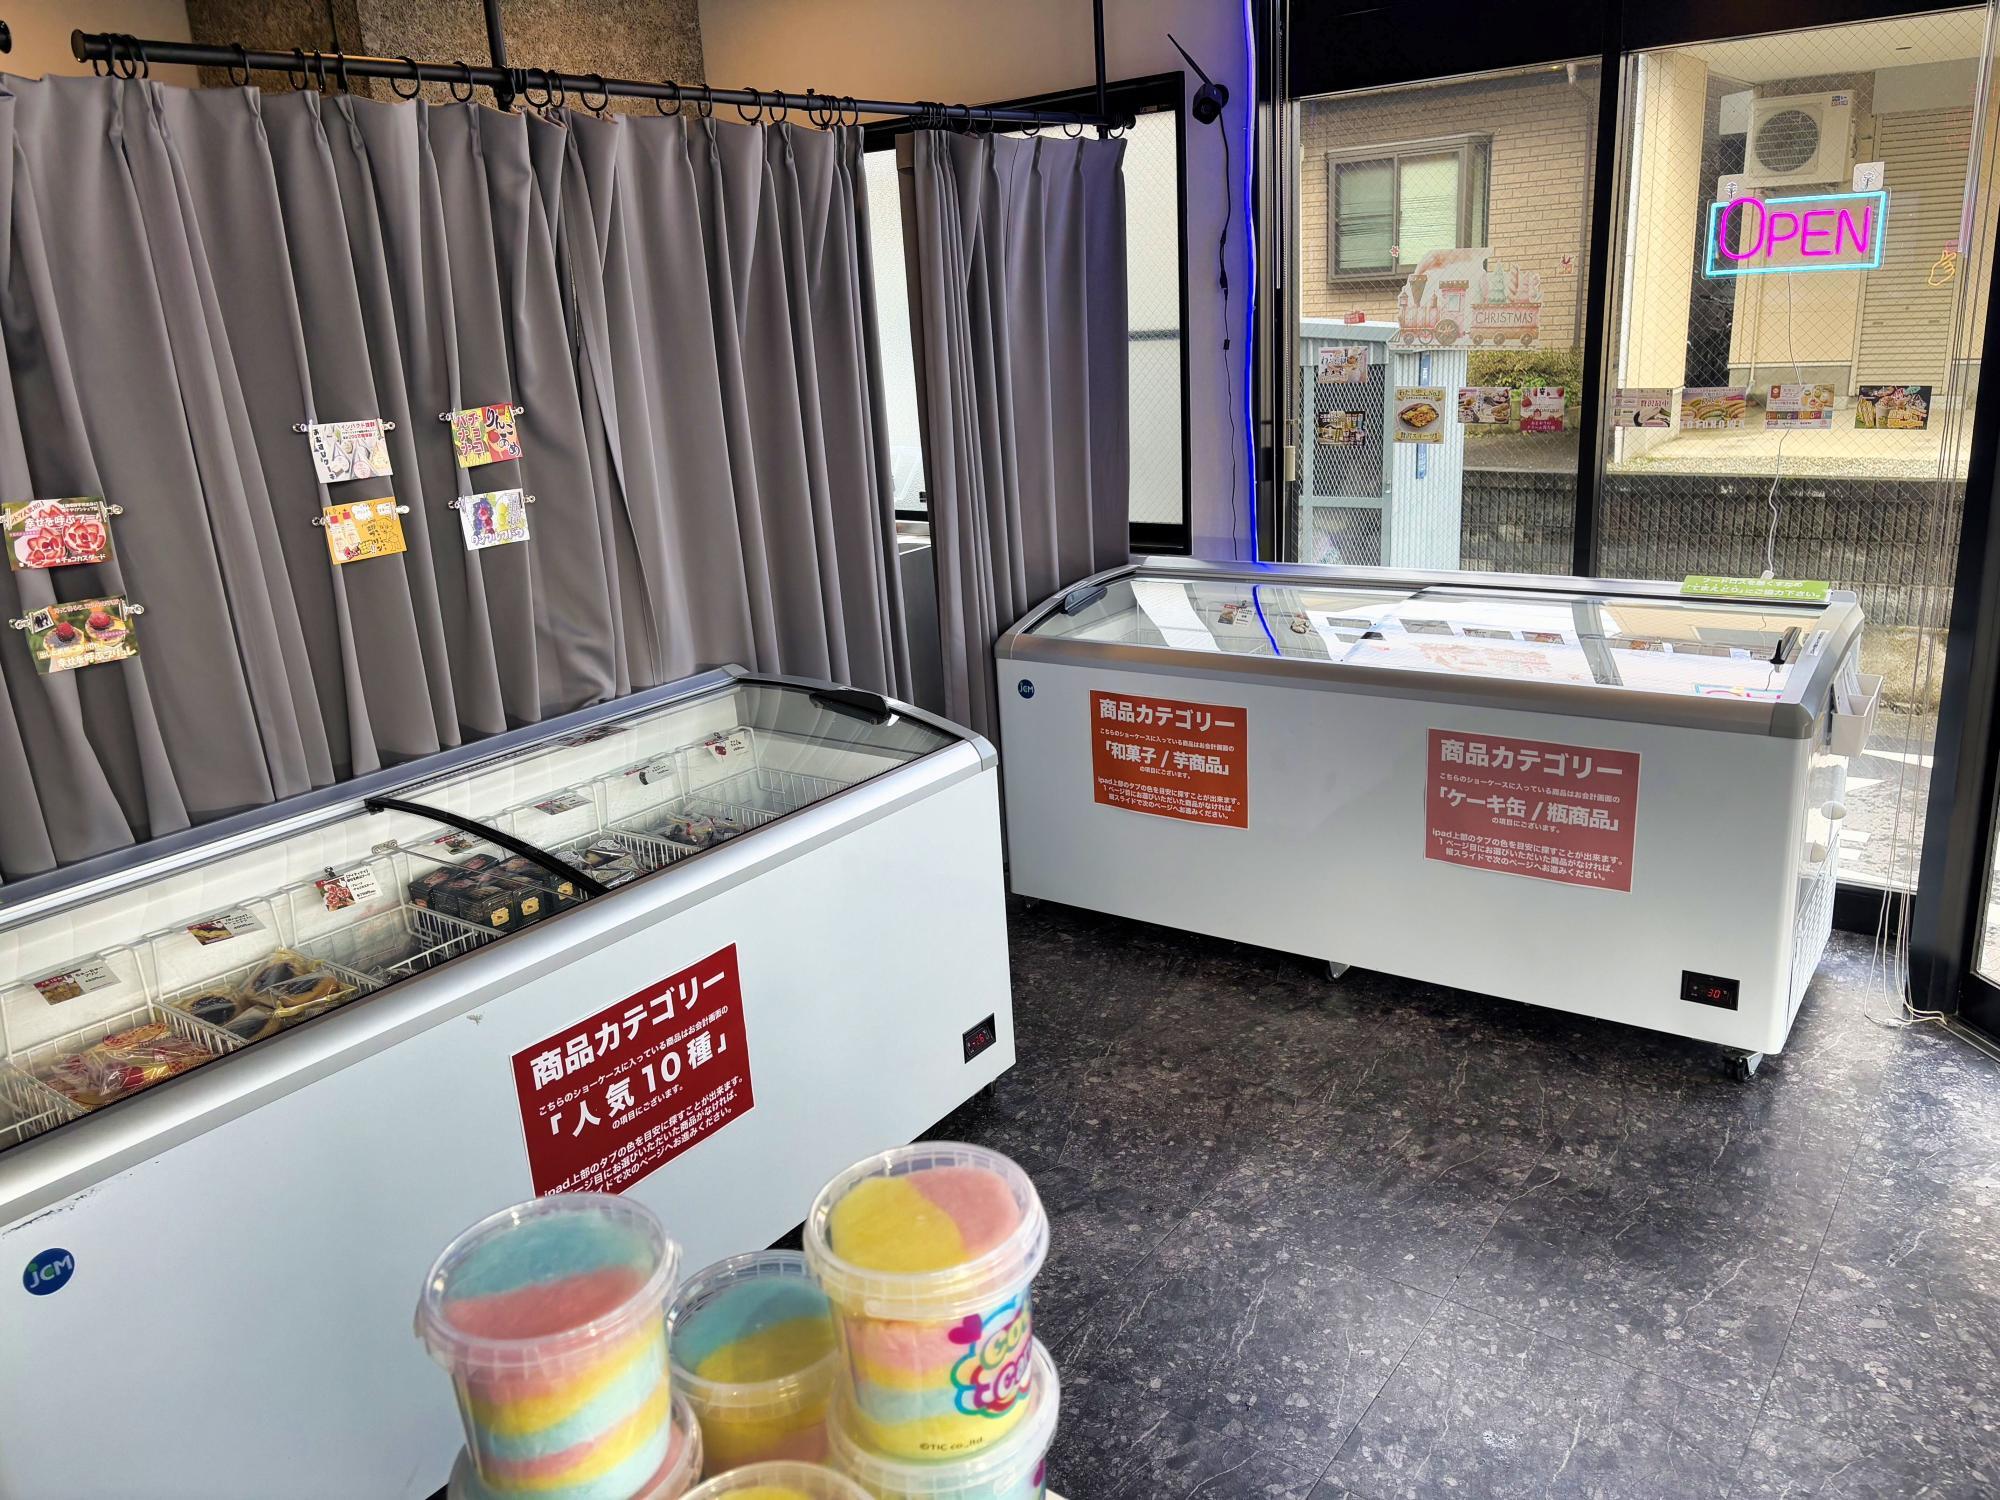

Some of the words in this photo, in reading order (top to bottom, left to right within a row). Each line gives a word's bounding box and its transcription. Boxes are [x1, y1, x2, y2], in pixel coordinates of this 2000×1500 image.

[1475, 312, 1533, 324] CHRISTMAS
[1099, 698, 1235, 732] 商品カテゴリー
[1440, 739, 1623, 779] 商品カテゴリー
[529, 971, 725, 1091] 商品カテゴリー
[539, 1005, 729, 1116] こちらのショーケースに入っている商品はお会計画面の
[612, 1085, 684, 1130] の項目にございます。
[568, 1092, 739, 1194] ージ目にお選びいただいた商品がなければ、
[29, 1255, 73, 1288] JCM
